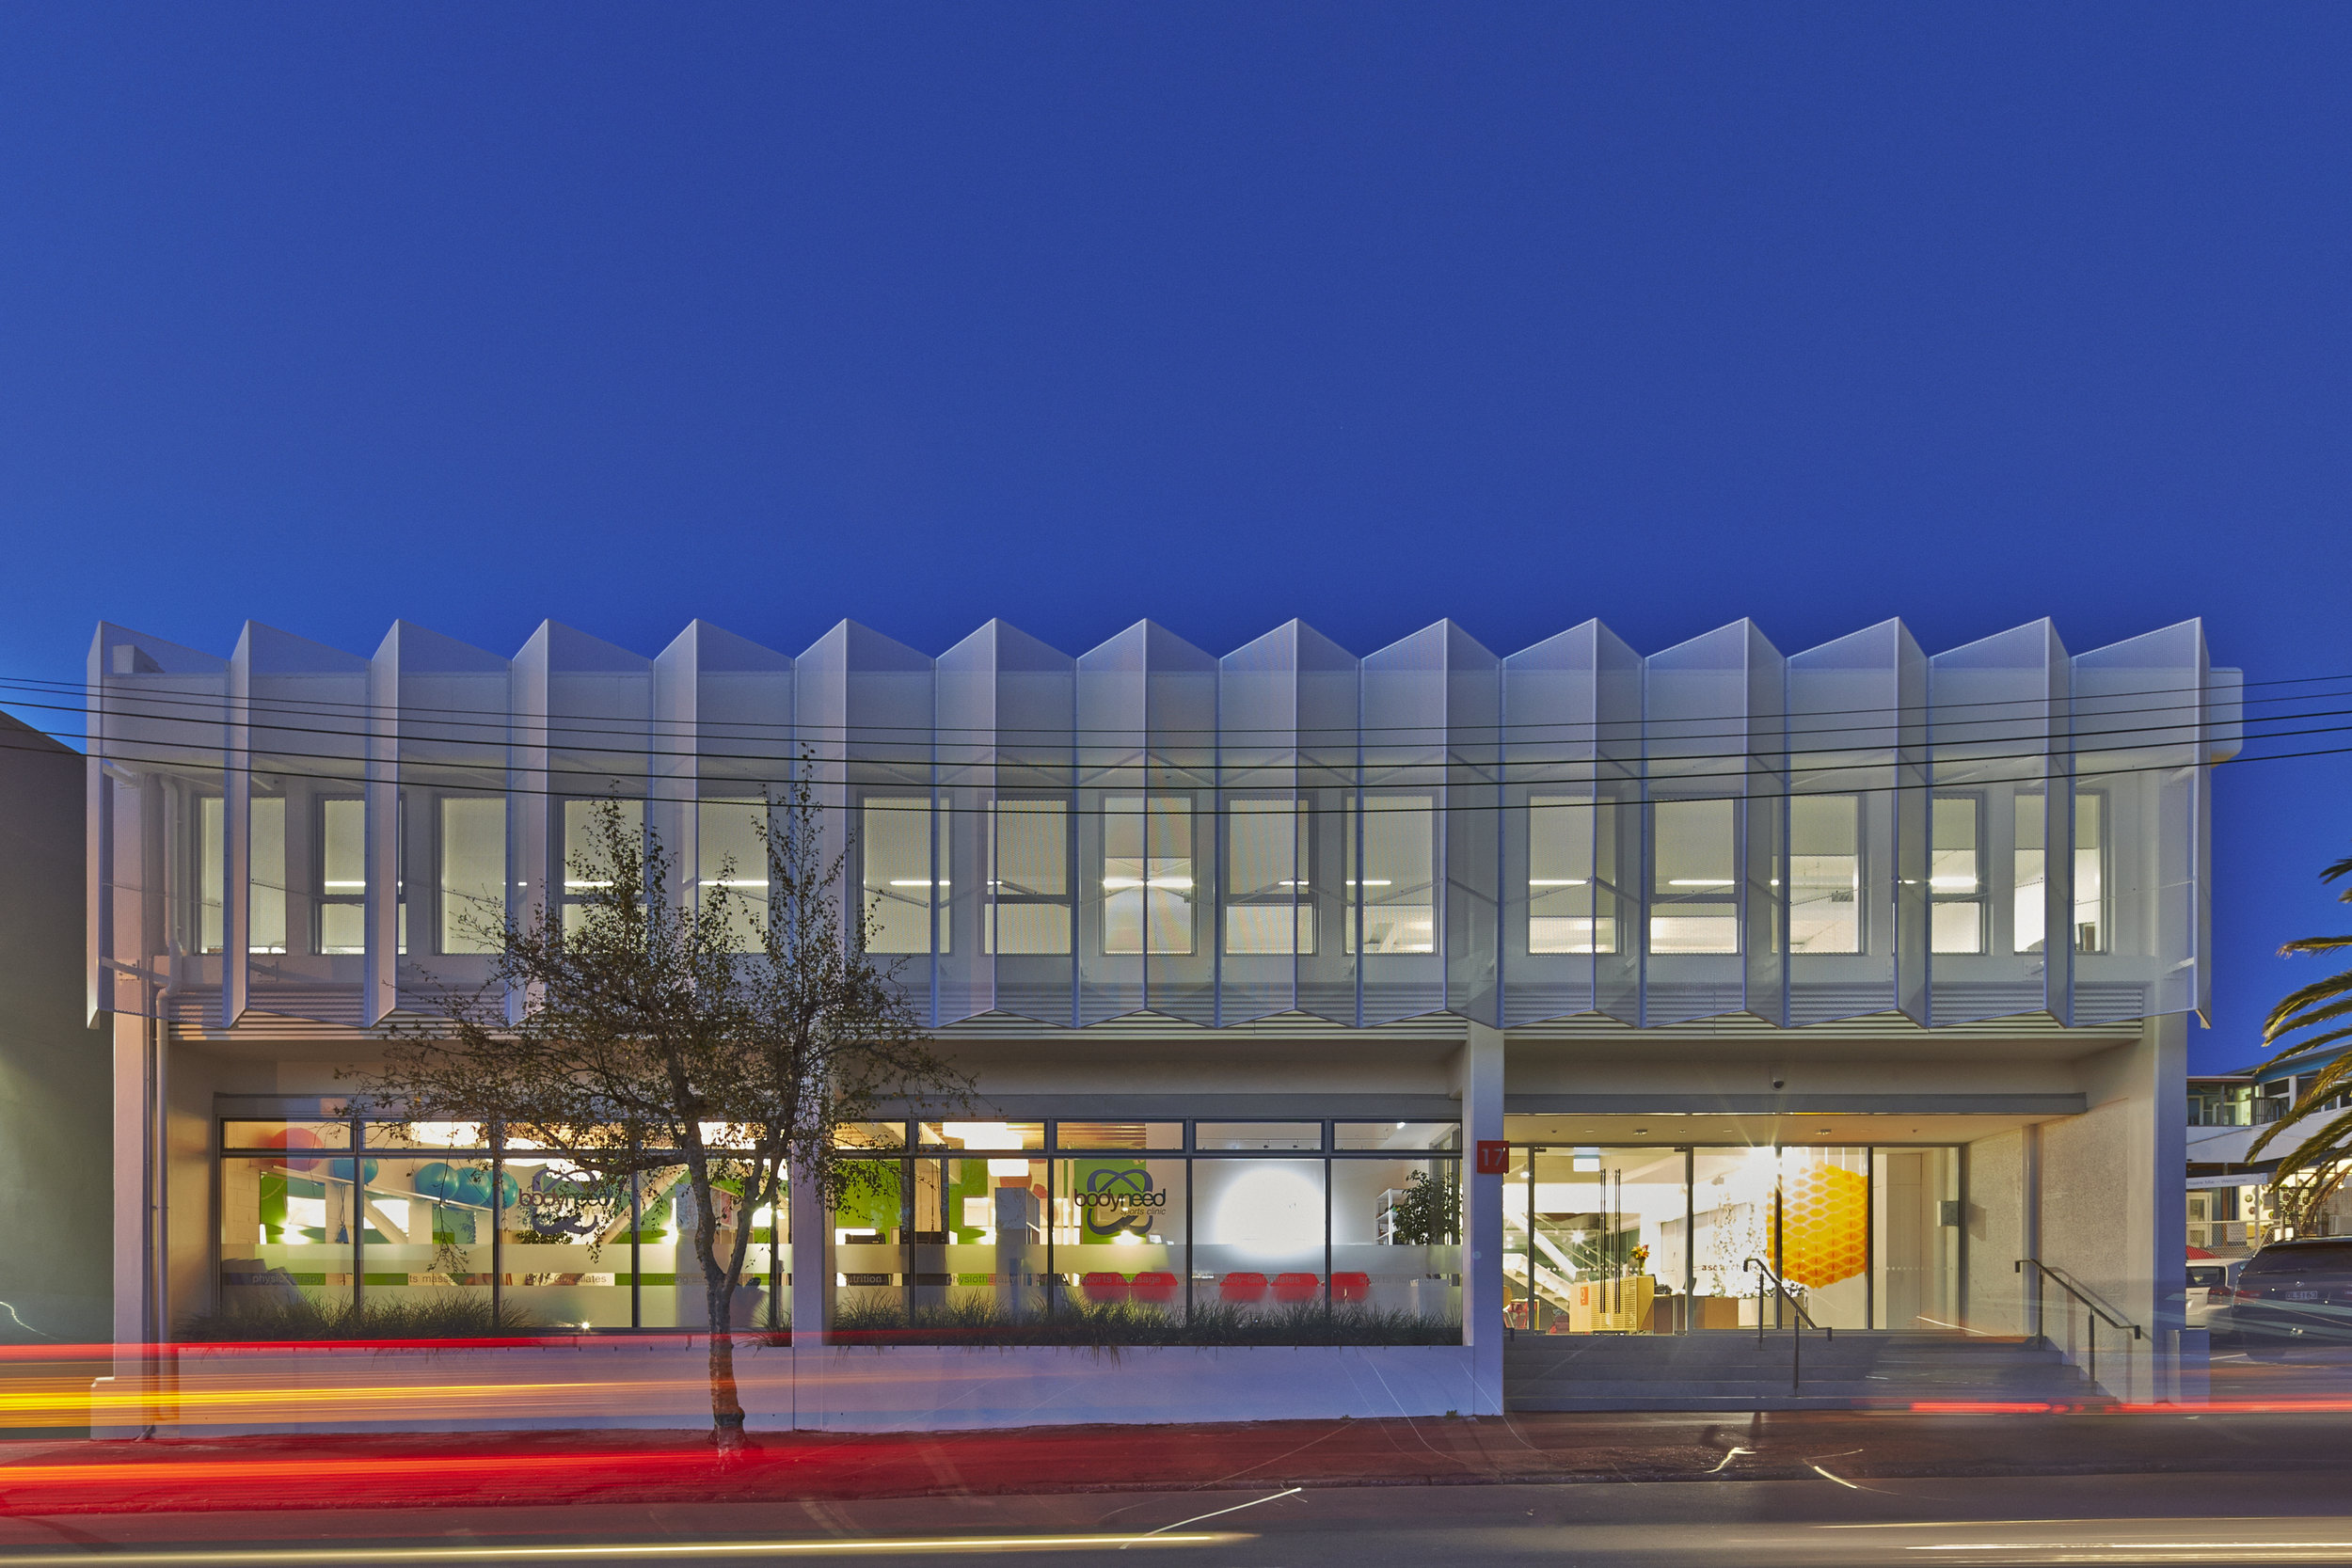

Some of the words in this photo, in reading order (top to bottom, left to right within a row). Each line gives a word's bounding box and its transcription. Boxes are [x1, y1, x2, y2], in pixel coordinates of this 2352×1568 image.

[1482, 1148, 1502, 1166] 17
[518, 1187, 612, 1212] bodyneed
[1073, 1188, 1166, 1212] bodyneed
[1120, 1208, 1144, 1217] sports
[252, 1274, 323, 1285] physioerapy
[422, 1275, 467, 1285] massa
[575, 1274, 607, 1285] ilates
[842, 1274, 882, 1283] utrition
